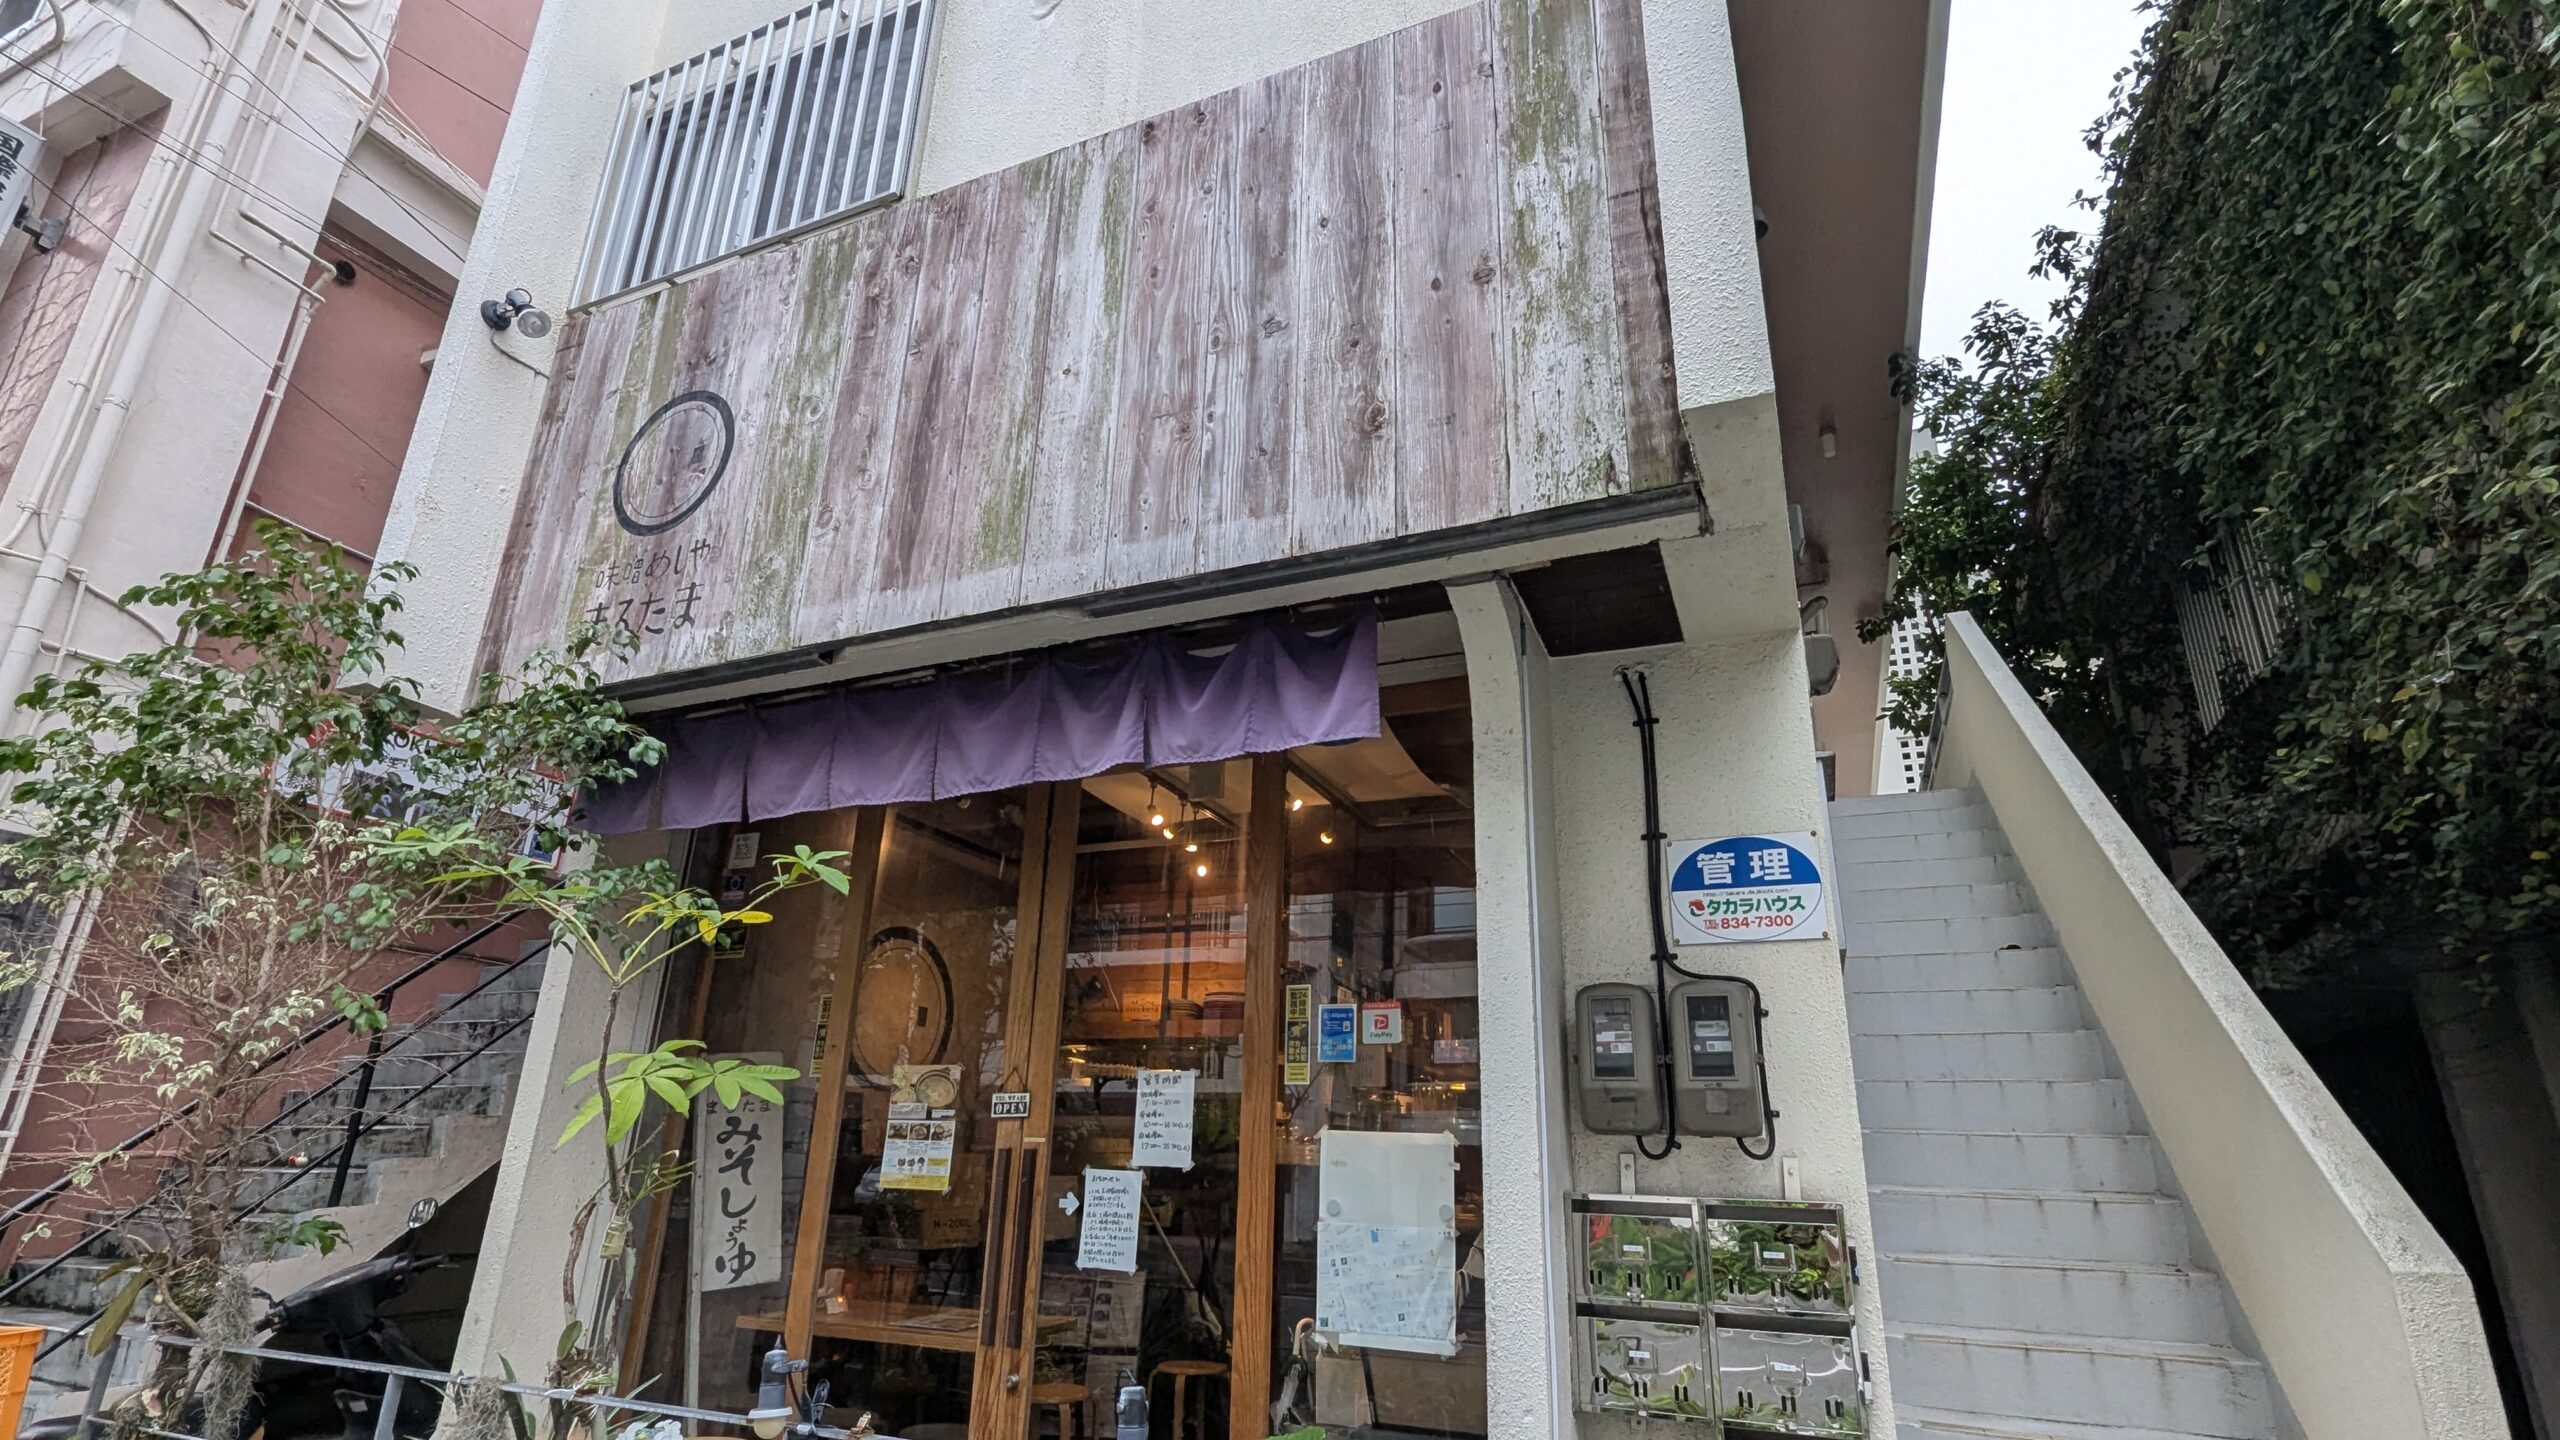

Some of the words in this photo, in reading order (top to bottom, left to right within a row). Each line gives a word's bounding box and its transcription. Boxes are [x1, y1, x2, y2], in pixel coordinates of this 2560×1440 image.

[595, 538, 711, 591] 味噌めしや
[1696, 848, 1792, 885] 管理
[1706, 895, 1806, 916] タカラハウス
[1720, 914, 1794, 930] 834-7300
[995, 1103, 1025, 1114] OPEN
[715, 1116, 763, 1286] みそしょうゆ
